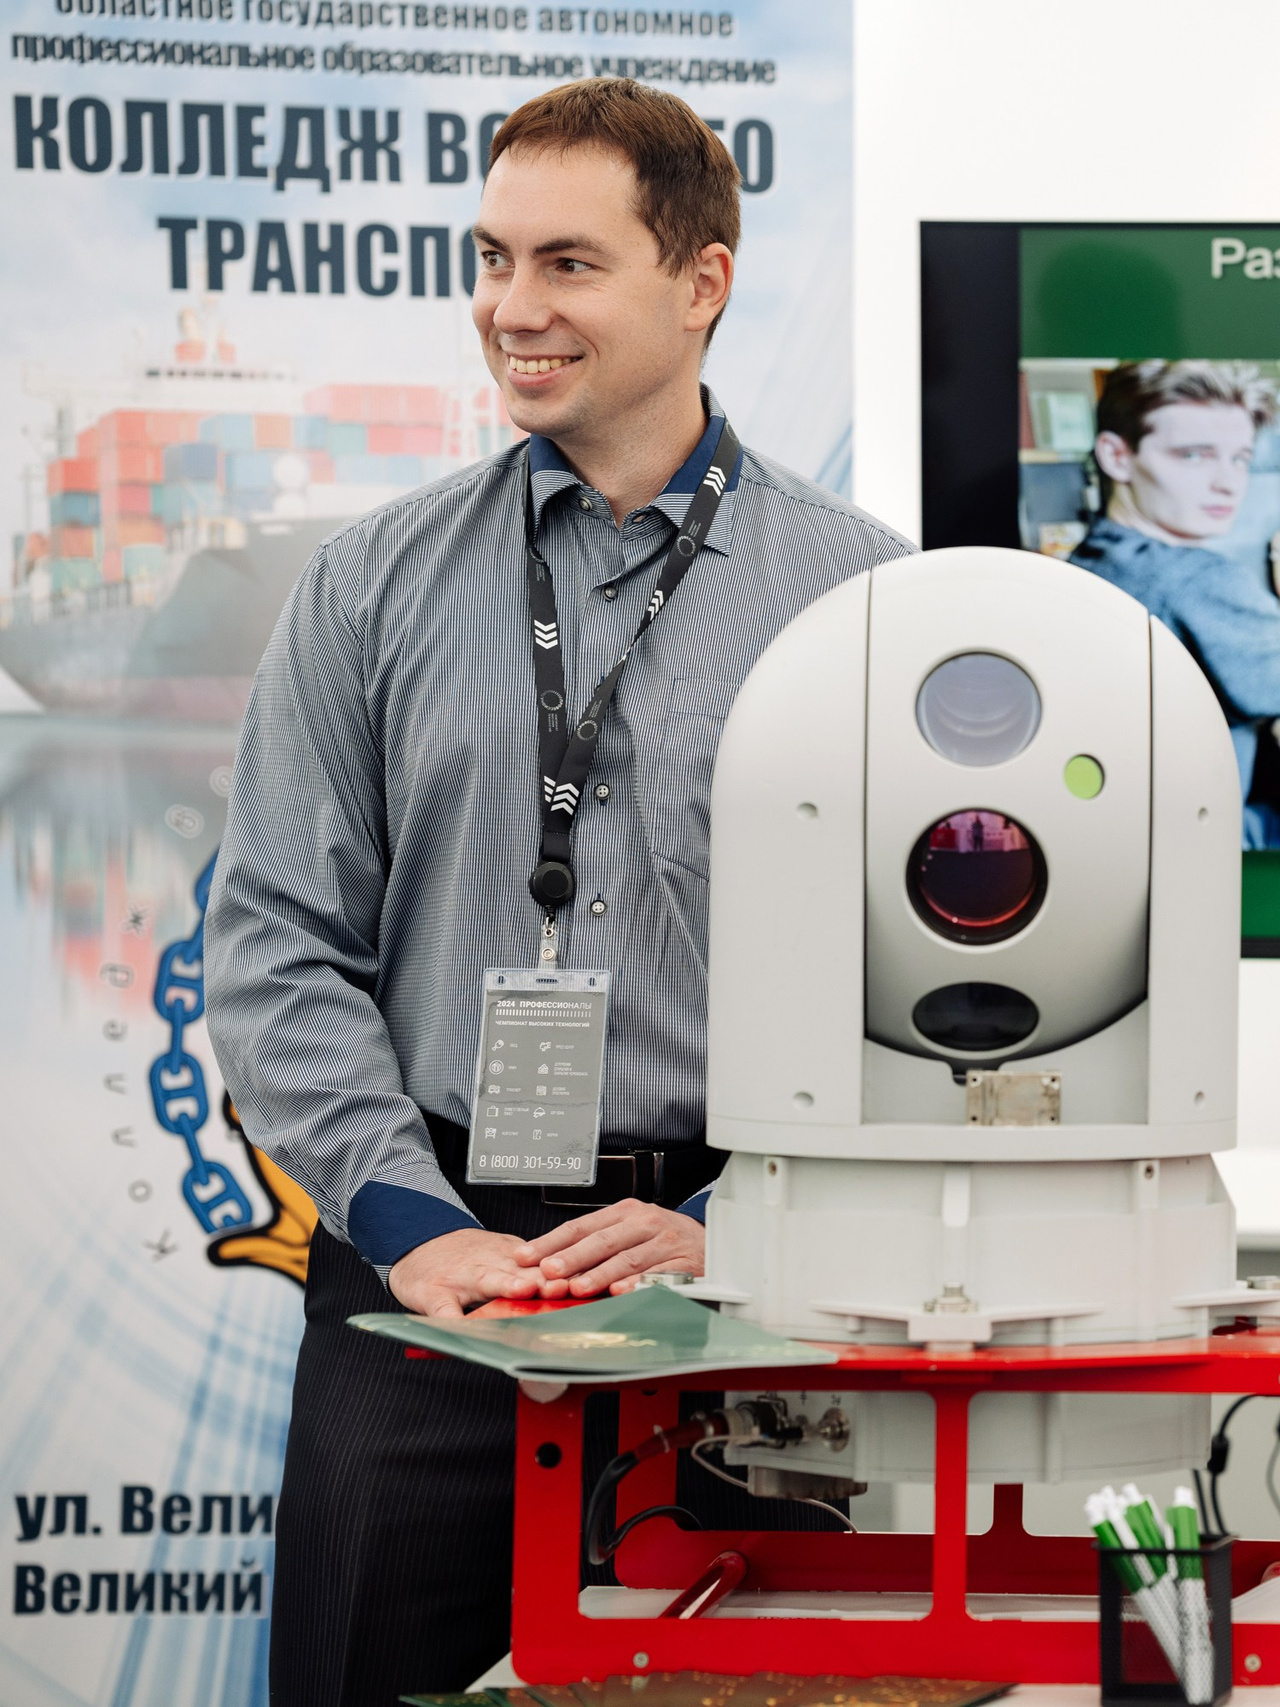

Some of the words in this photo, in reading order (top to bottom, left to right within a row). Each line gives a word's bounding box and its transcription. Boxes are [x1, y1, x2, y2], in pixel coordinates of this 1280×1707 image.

[539, 10, 733, 37] автономное
[12, 33, 315, 69] профессиональное
[14, 95, 400, 193] КОЛЛЕДЖ
[496, 1000, 516, 1008] 2024
[519, 1001, 592, 1010] ПРОФЕССИОНАЛЫ
[479, 1155, 488, 1168] 8
[491, 1155, 519, 1169] (800)
[522, 1156, 581, 1170] 301-59-90
[15, 1495, 102, 1541] ул.
[121, 1485, 274, 1536] Вели
[14, 1558, 264, 1615] Великий
